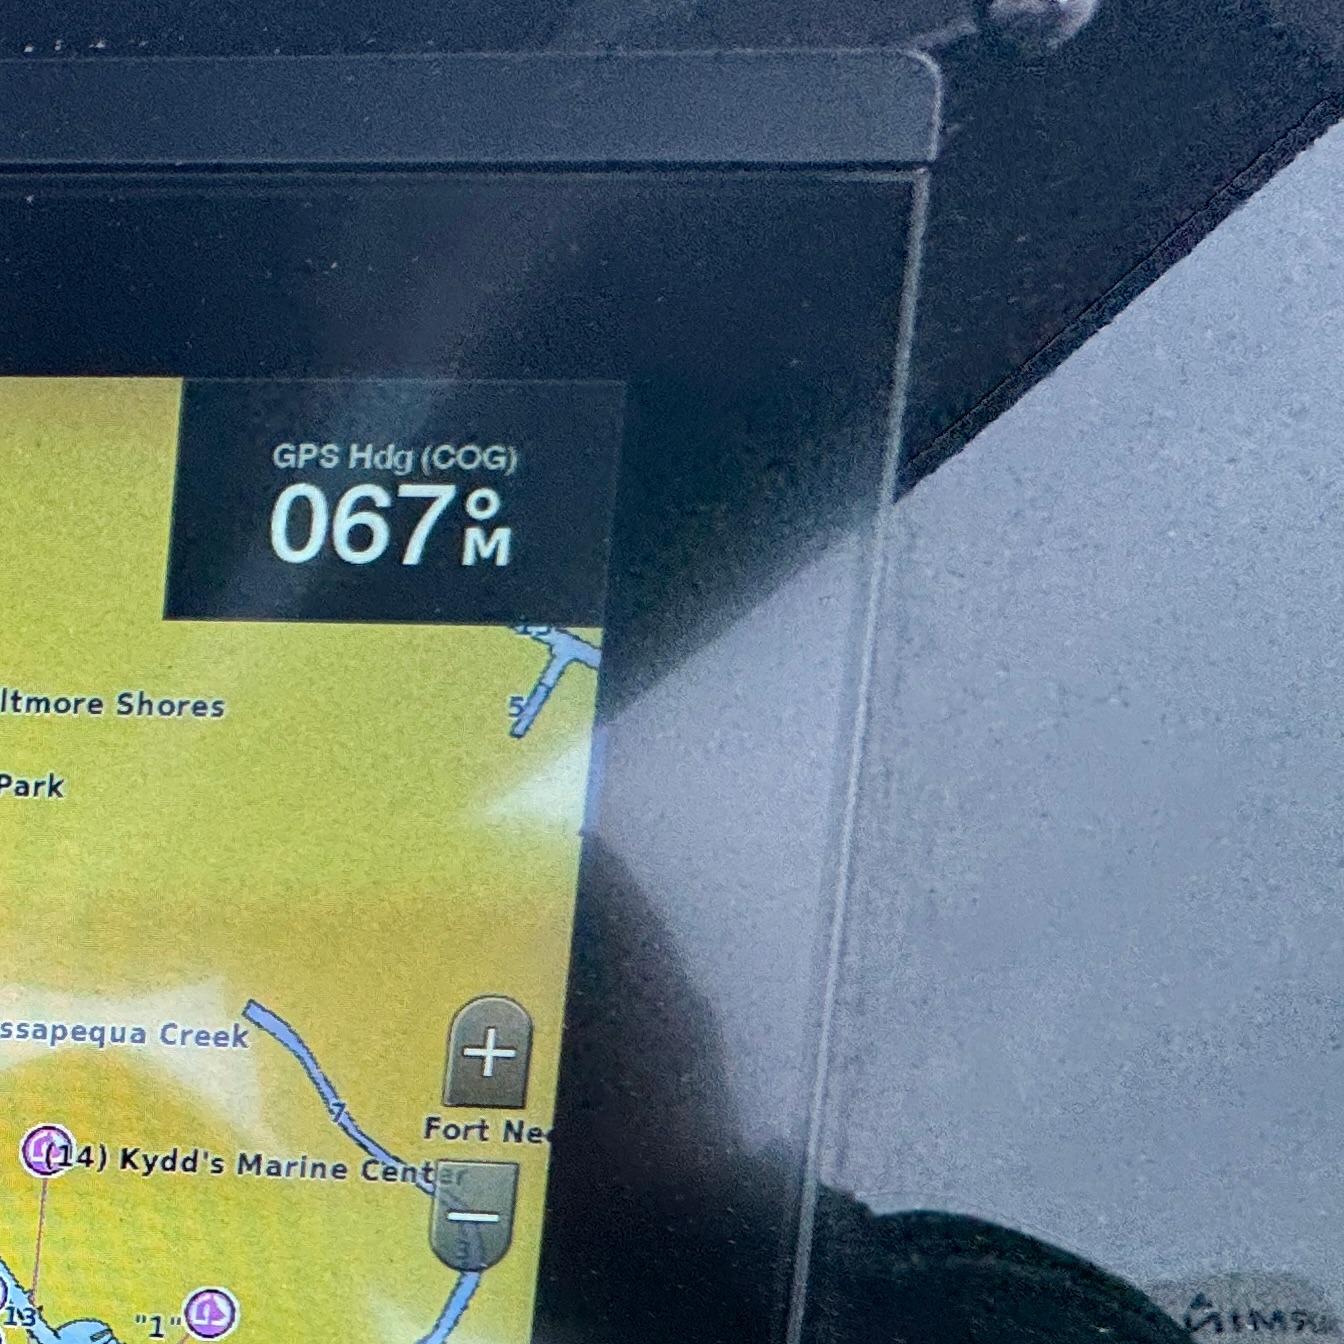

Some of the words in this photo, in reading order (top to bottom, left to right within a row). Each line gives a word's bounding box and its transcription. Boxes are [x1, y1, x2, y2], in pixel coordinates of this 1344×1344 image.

[272, 443, 341, 470] GPS
[348, 443, 414, 475] Hdg
[421, 444, 518, 474] (COG)
[116, 692, 226, 719] Shores
[509, 696, 525, 718] 5
[160, 1022, 250, 1048] Creek
[424, 1116, 489, 1142] Fort
[45, 1145, 107, 1171] (14)
[120, 1148, 224, 1178] Kydd's
[238, 1152, 348, 1180] Marine
[360, 1159, 467, 1186] Center
[4, 1306, 36, 1327] 13
